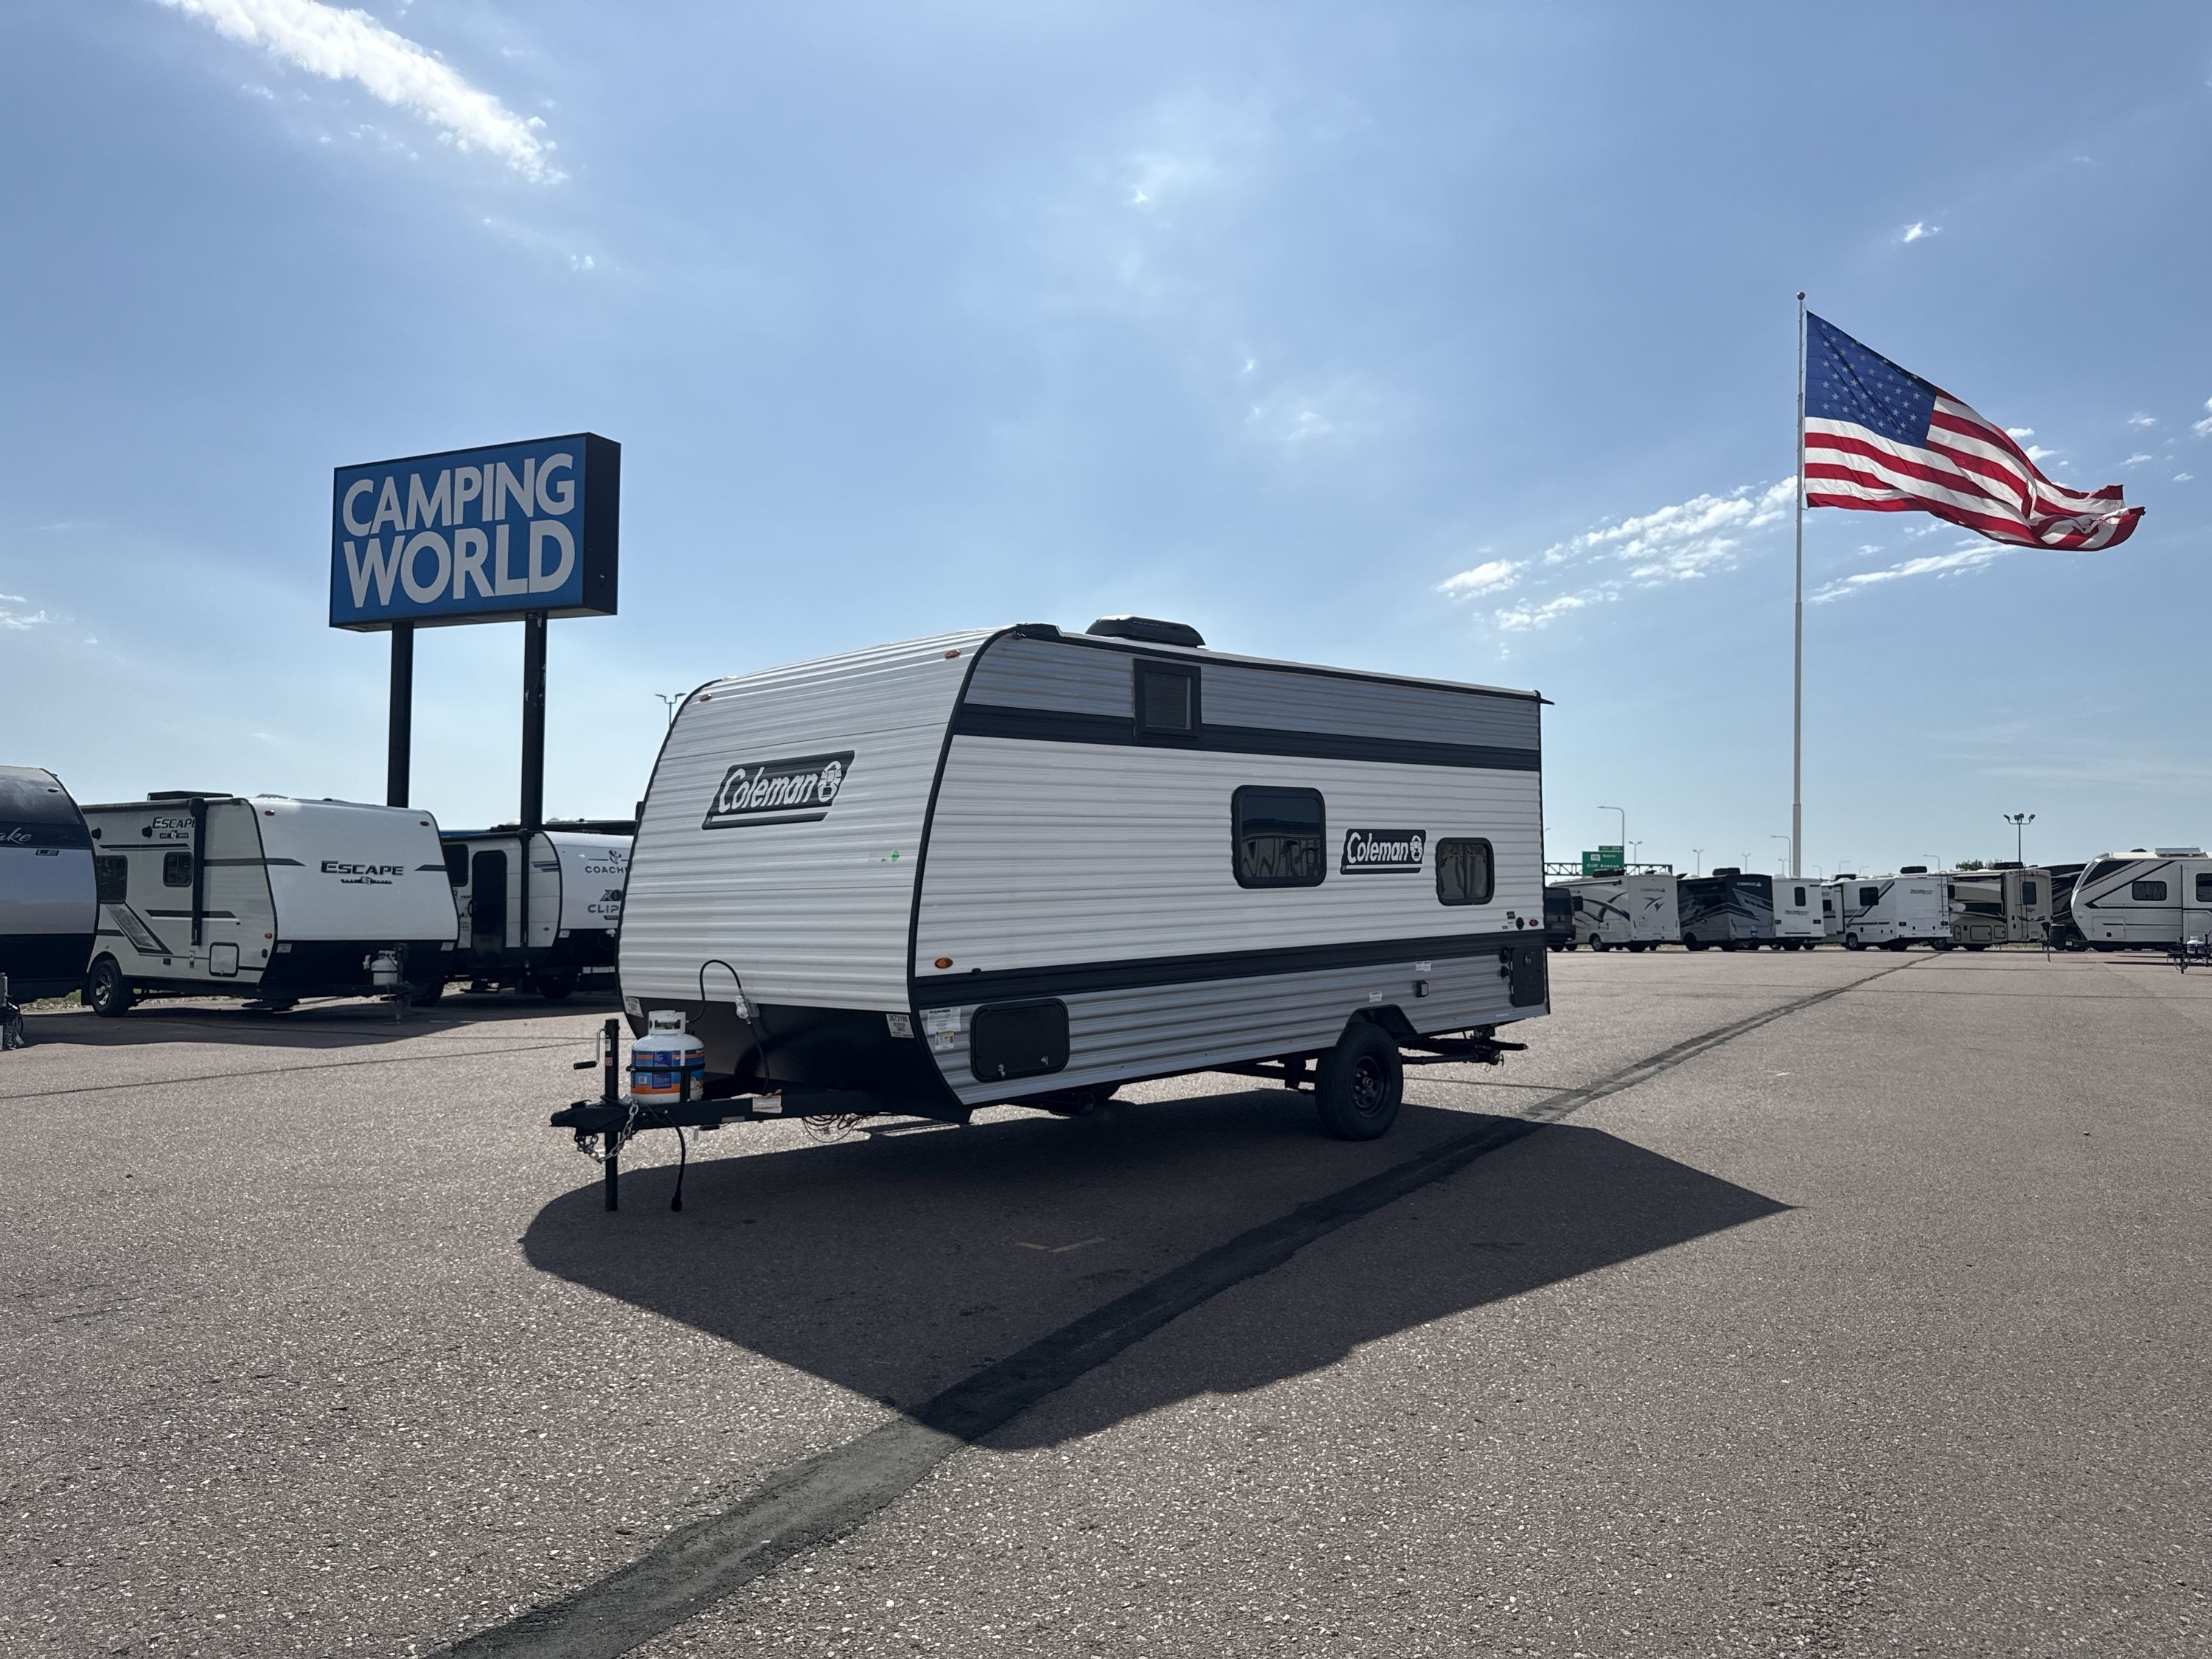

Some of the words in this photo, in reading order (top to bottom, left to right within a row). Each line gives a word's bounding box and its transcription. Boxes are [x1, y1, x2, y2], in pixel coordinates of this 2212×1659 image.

[342, 453, 575, 538] CAMPING
[343, 519, 576, 608] WORLD
[718, 766, 819, 813] Coleman
[321, 860, 405, 875] ESCAPE
[1347, 831, 1410, 864] Coleman
